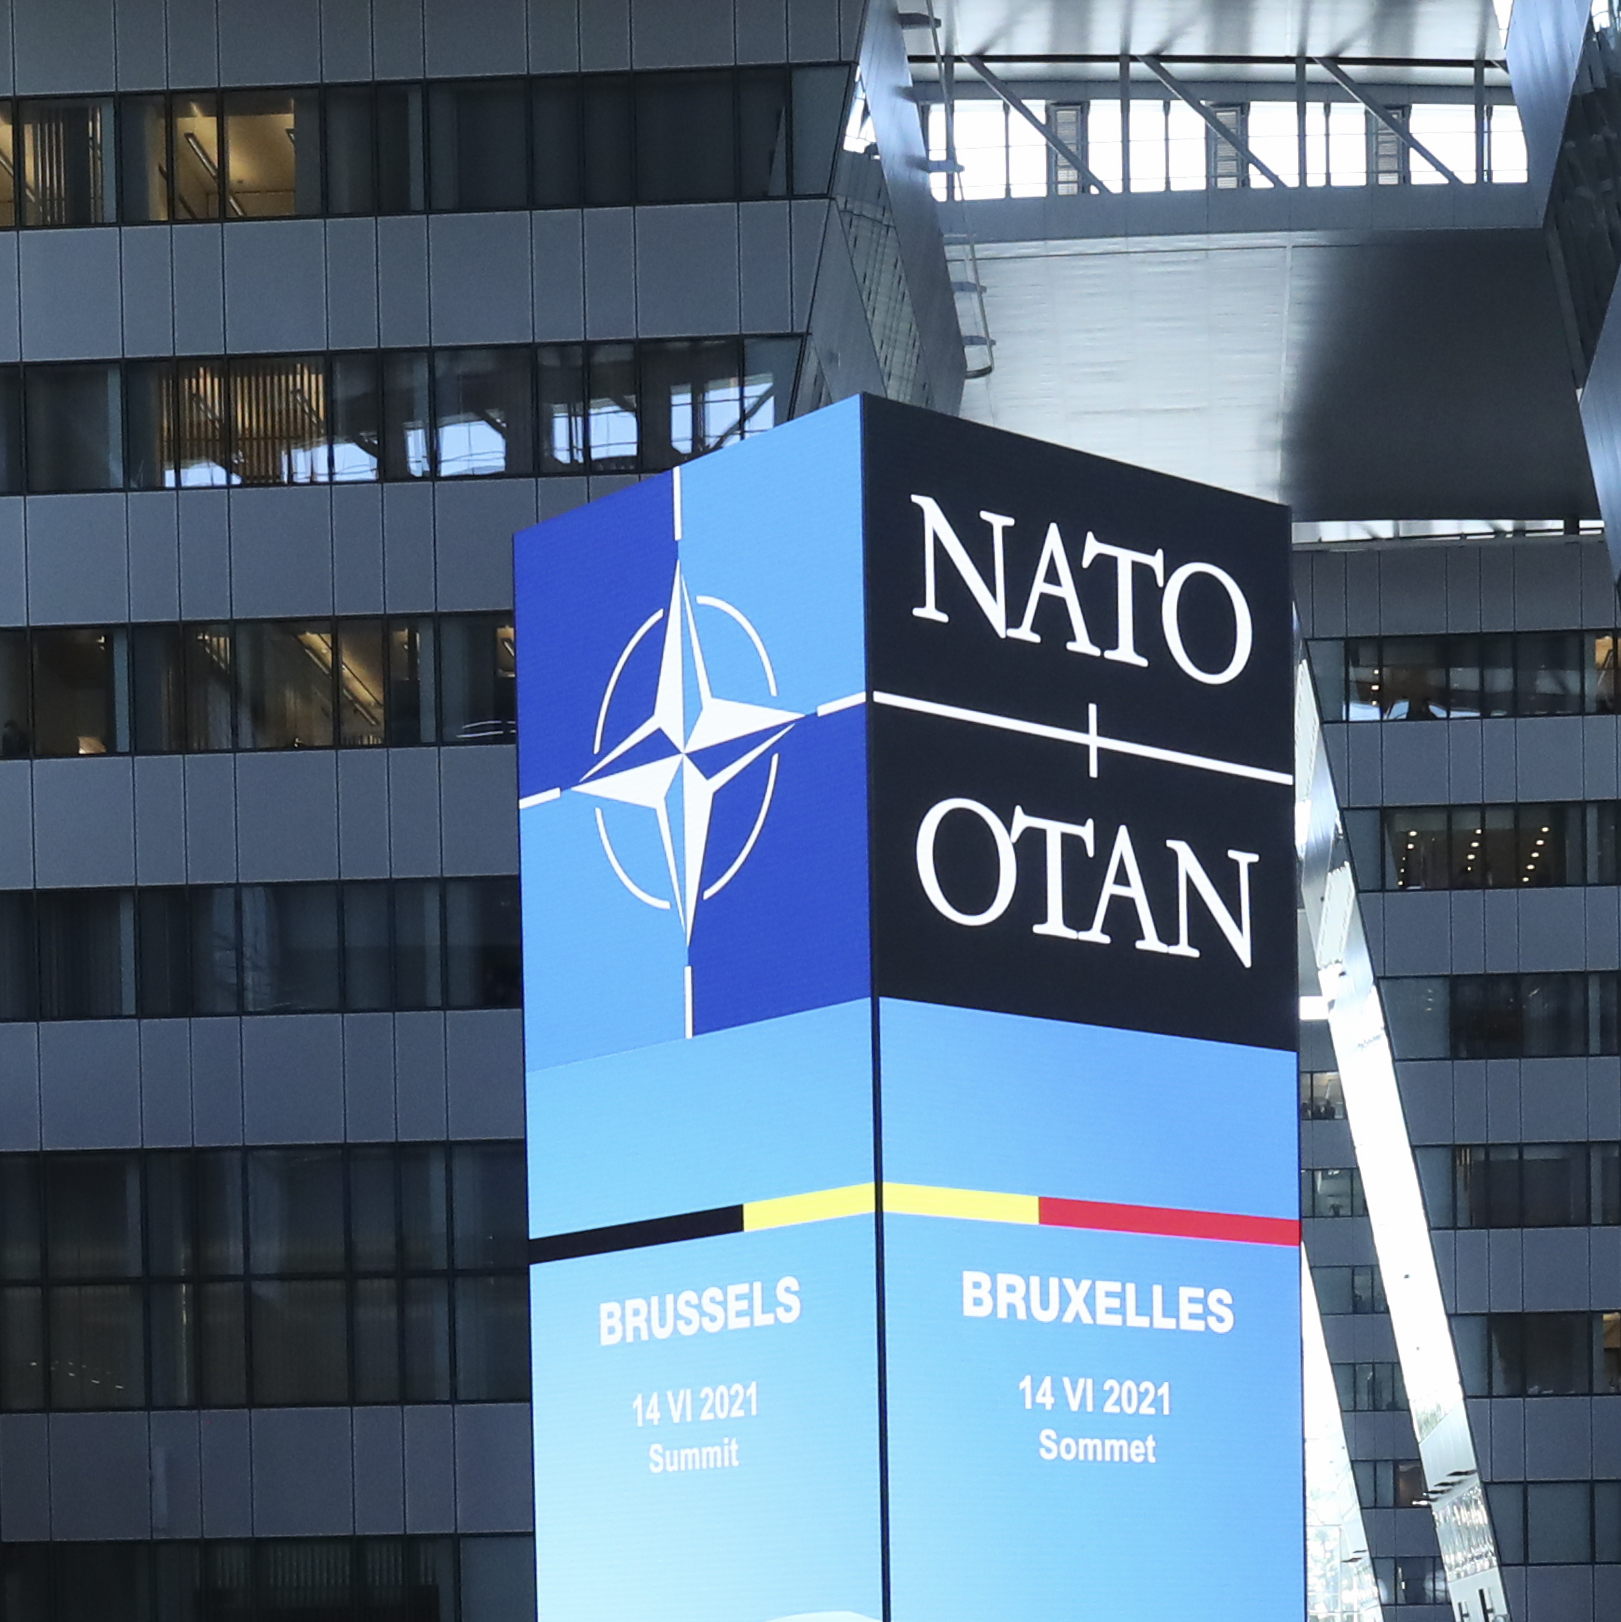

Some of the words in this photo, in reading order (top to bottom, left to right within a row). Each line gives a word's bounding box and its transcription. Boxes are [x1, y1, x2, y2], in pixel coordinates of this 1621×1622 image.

[910, 494, 1253, 685] NATO
[915, 796, 1260, 969] OTAN
[599, 1275, 801, 1346] BRUSSELS
[962, 1269, 1235, 1334] BRUXELLES
[631, 1391, 661, 1428] 14
[666, 1388, 693, 1424] VI
[699, 1381, 758, 1421] 2021
[1017, 1374, 1055, 1411] 14
[1062, 1376, 1095, 1413] VI
[1103, 1378, 1171, 1416] 2021
[648, 1438, 739, 1474] Summit
[1038, 1428, 1157, 1464] Sommet
